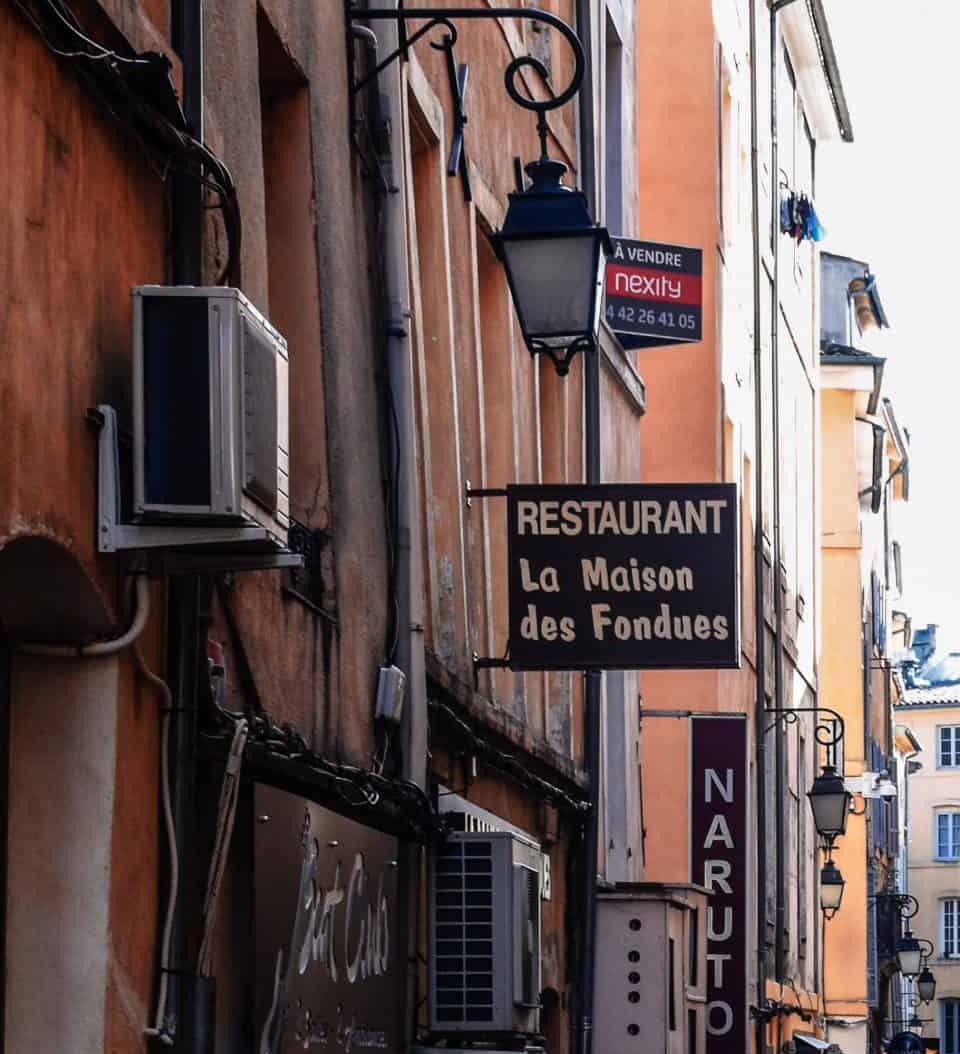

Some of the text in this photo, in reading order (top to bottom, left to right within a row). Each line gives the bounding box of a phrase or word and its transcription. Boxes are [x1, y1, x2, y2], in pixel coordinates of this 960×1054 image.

[614, 242, 682, 267] À VENDRE
[615, 272, 681, 298] nexity
[617, 307, 635, 322] 42
[638, 309, 655, 324] 26
[658, 312, 675, 327] 41
[678, 314, 696, 329] 05
[517, 499, 728, 536] RESTAURANT
[519, 557, 694, 592] La Maison
[520, 602, 729, 641] des Fondues
[703, 767, 734, 1036] NARUTO
